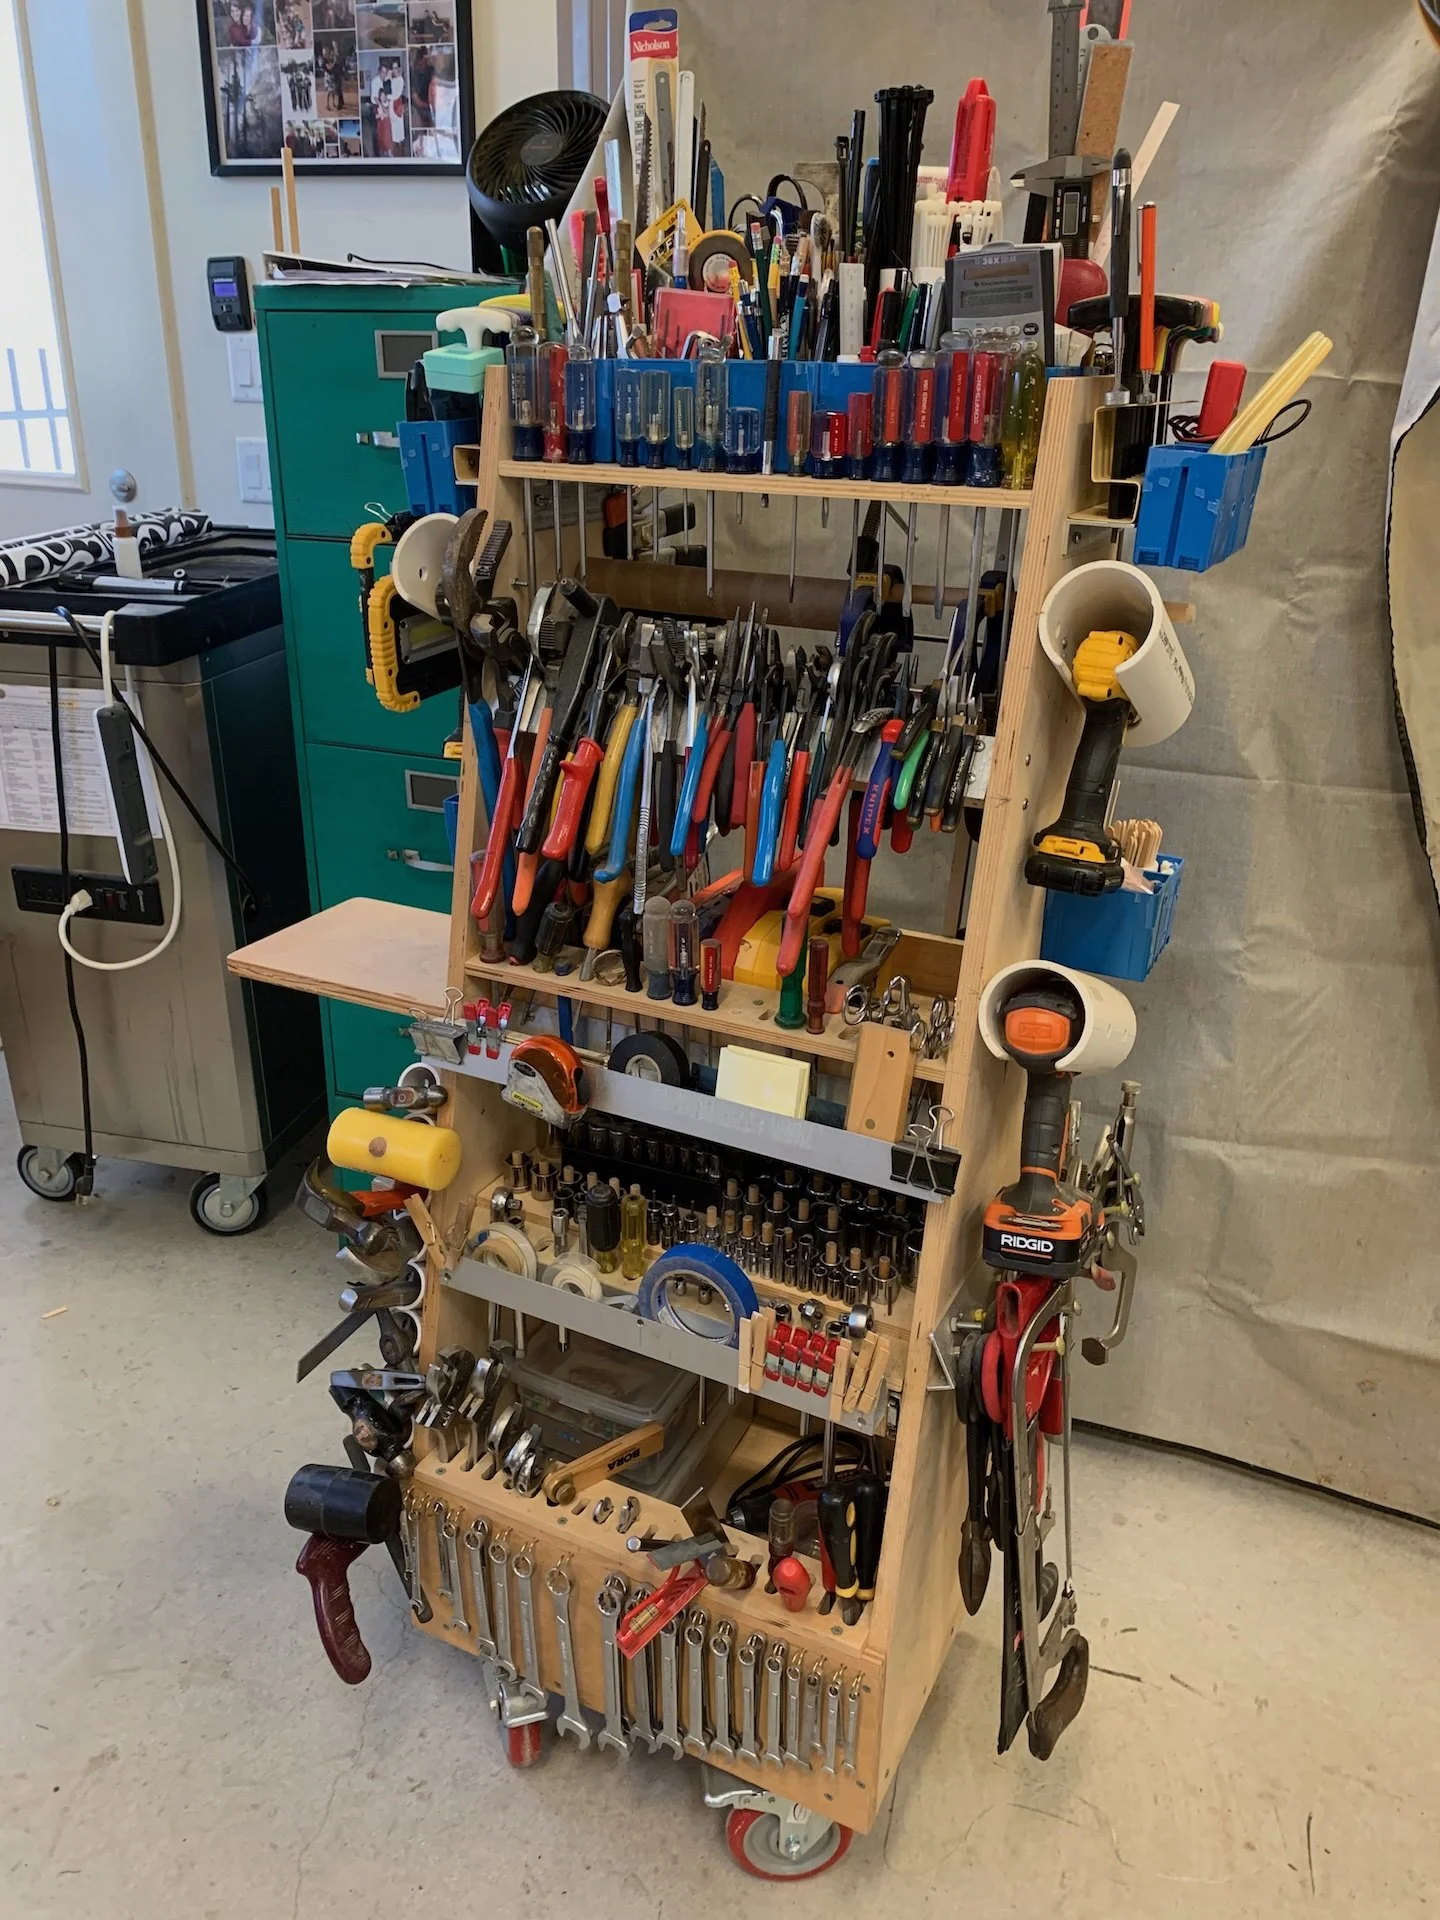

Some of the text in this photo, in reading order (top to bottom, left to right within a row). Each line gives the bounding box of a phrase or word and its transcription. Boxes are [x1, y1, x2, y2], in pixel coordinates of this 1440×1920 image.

[633, 39, 670, 53] Nicholson
[982, 256, 1000, 265] 36X
[973, 376, 983, 424] CRAFTSMAN
[863, 784, 880, 835] KNIPEX
[1000, 1233, 1054, 1253] RIDGID
[608, 1448, 640, 1471] BORA
